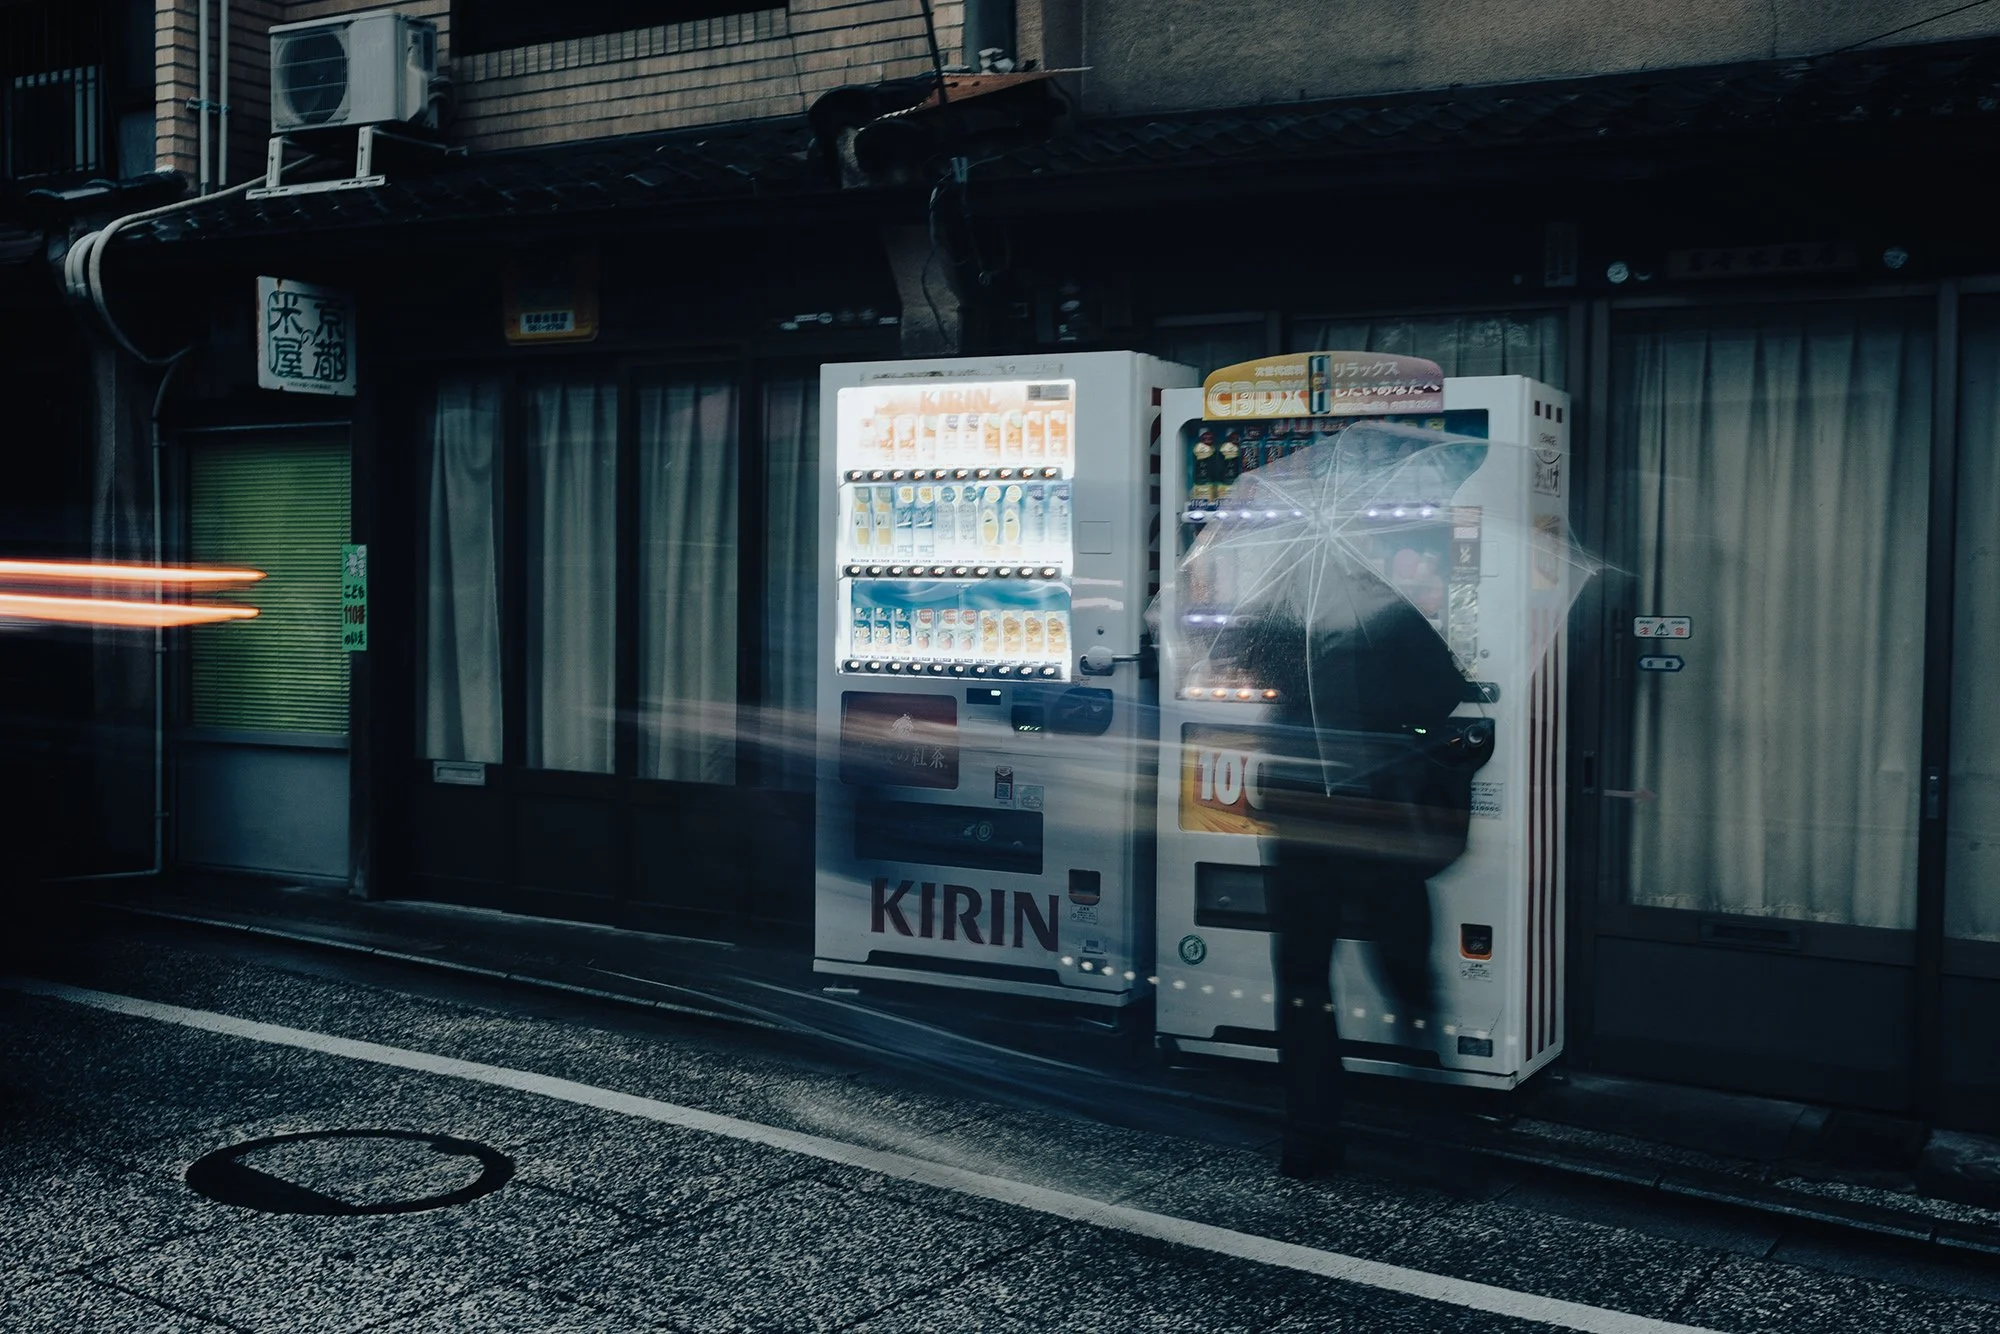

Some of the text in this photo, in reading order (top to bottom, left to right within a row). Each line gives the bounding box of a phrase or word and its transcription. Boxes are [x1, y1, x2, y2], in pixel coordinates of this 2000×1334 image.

[1333, 361, 1399, 378] リラックス
[344, 585, 365, 600] こども
[344, 605, 364, 625] 110番
[344, 631, 364, 646] のいえ
[871, 877, 1059, 953] KIRIN
